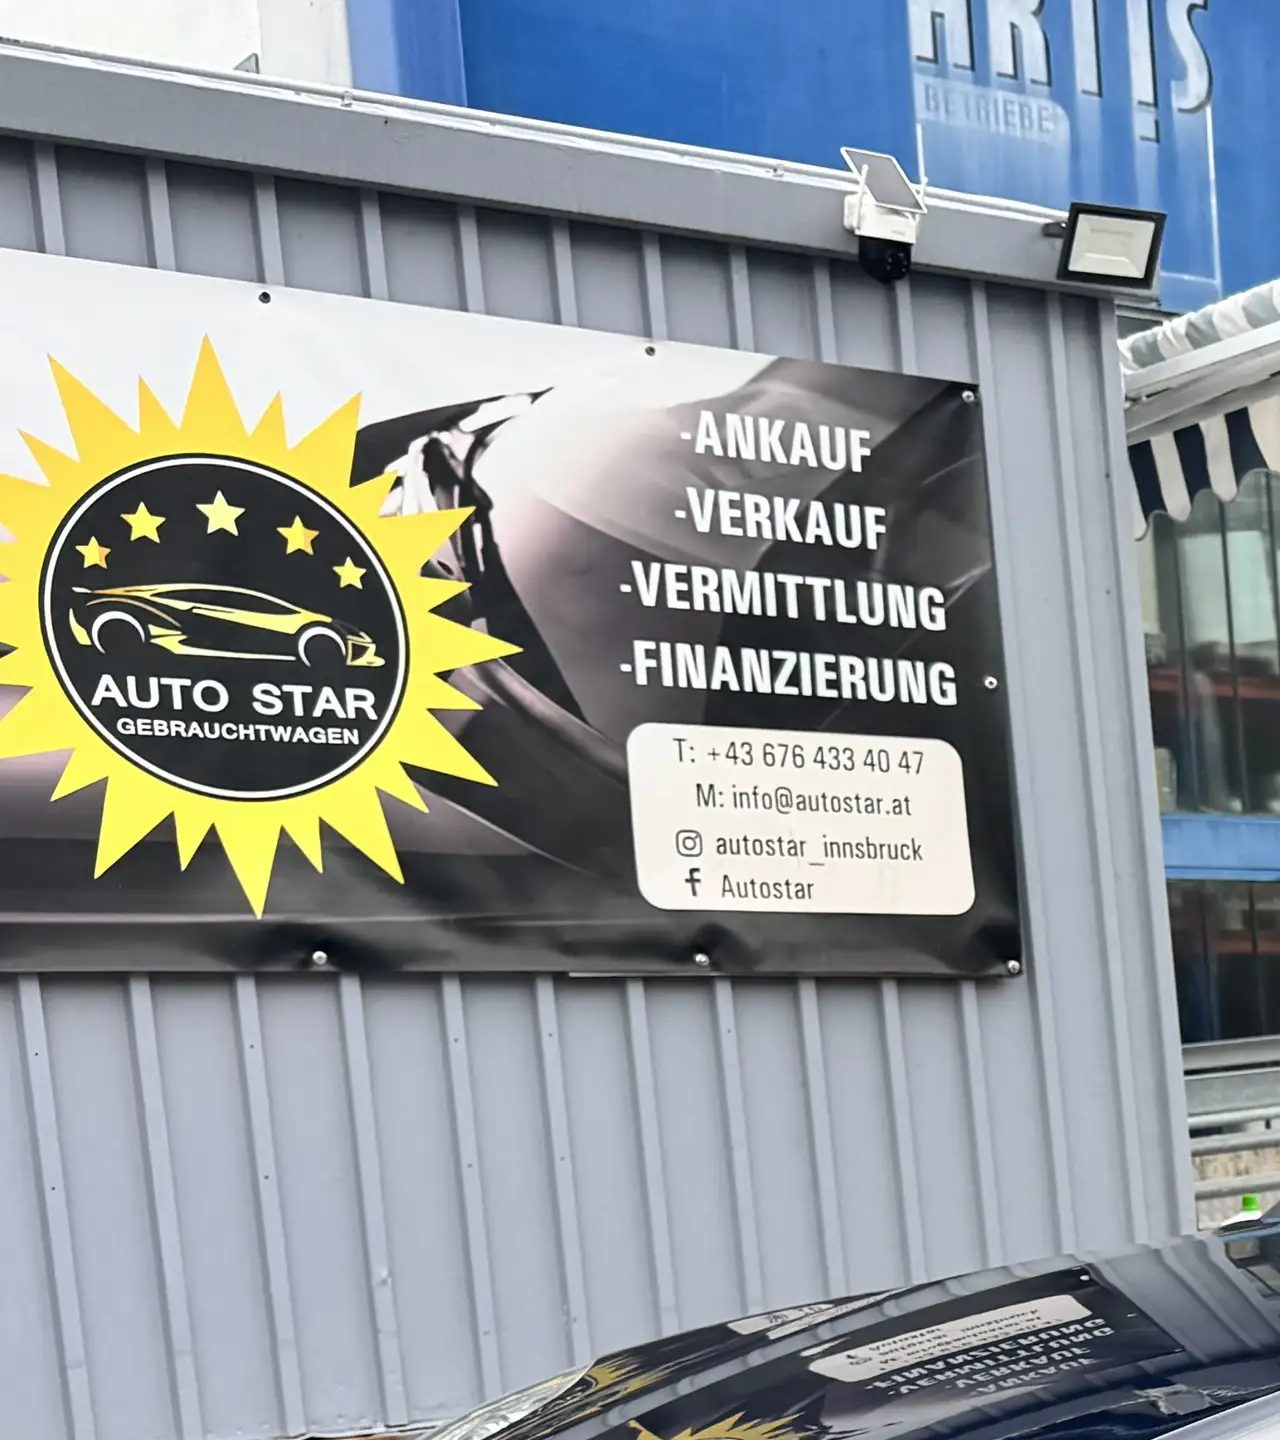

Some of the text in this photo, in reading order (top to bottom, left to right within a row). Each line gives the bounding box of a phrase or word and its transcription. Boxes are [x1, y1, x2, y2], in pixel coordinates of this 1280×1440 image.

[923, 82, 1054, 133] BETRIEBE
[90, 673, 379, 721] AUTO STAR
[116, 717, 360, 746] GEBRAUCHTWAGEN
[672, 737, 925, 775] T: +43 676 433 40 47
[695, 782, 913, 817] M: info@autostar.at
[715, 834, 924, 866] autostar_innsbruck
[720, 873, 815, 900] Autostar
